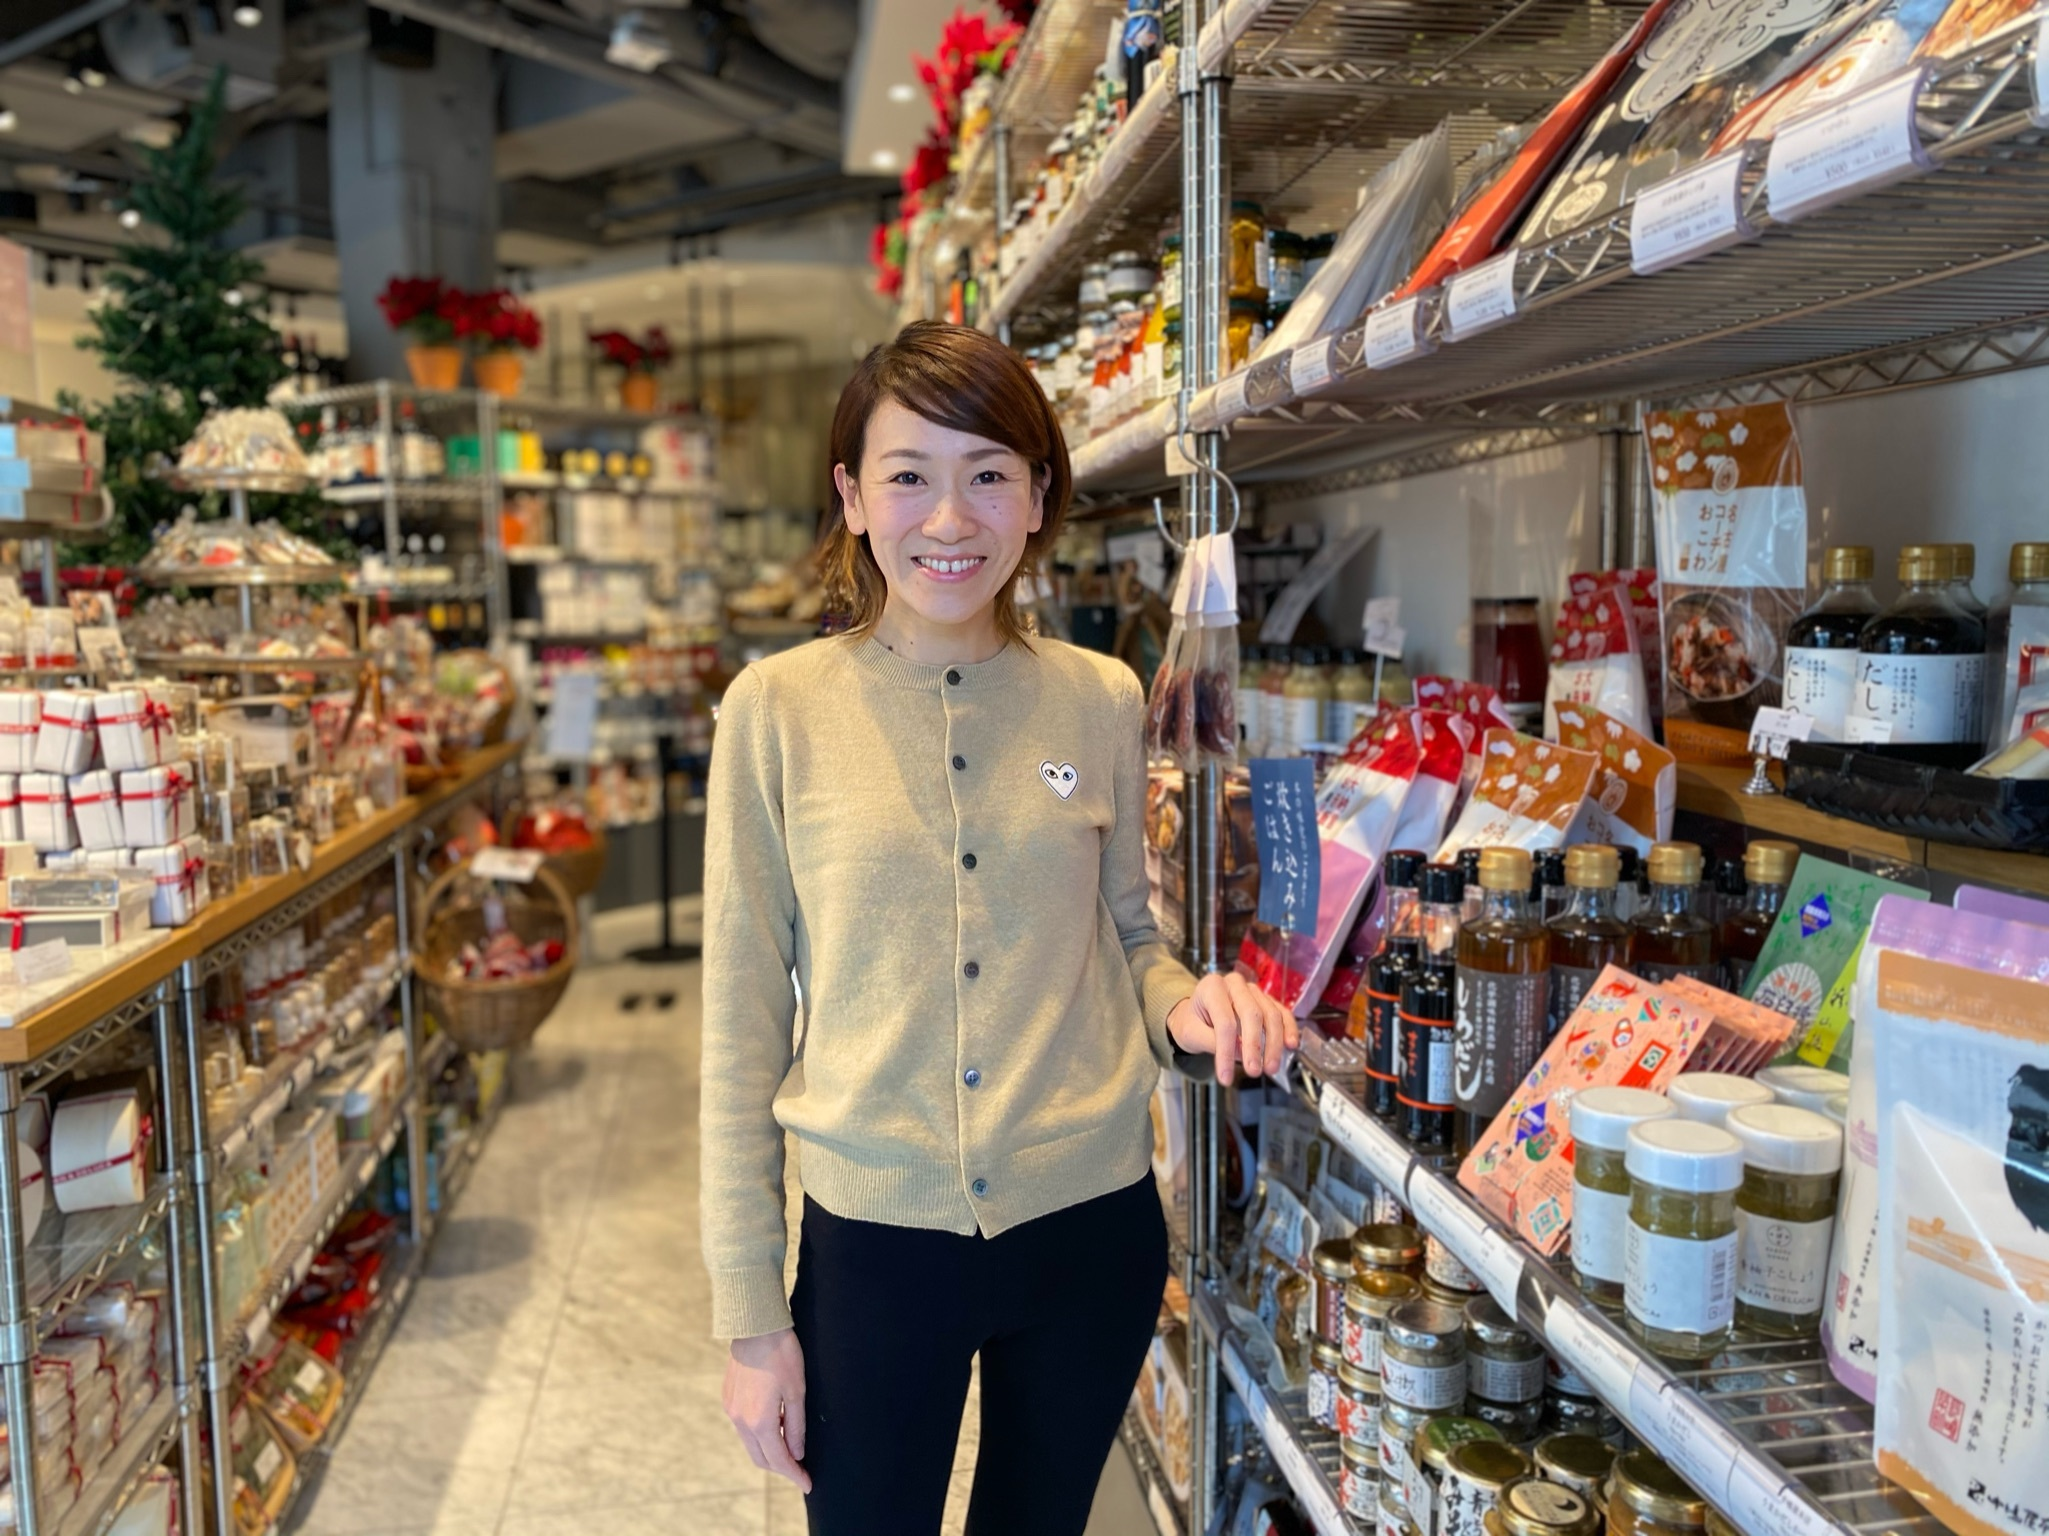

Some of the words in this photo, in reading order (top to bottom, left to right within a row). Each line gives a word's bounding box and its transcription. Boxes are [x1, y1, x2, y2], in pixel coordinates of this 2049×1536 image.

[1693, 504, 1713, 571] おこわ
[1707, 504, 1726, 572] コーチン
[1863, 660, 1889, 721] だし
[1264, 781, 1284, 873] ごはん
[1276, 781, 1298, 910] 炊き込み
[1455, 977, 1484, 1101] しろだし
